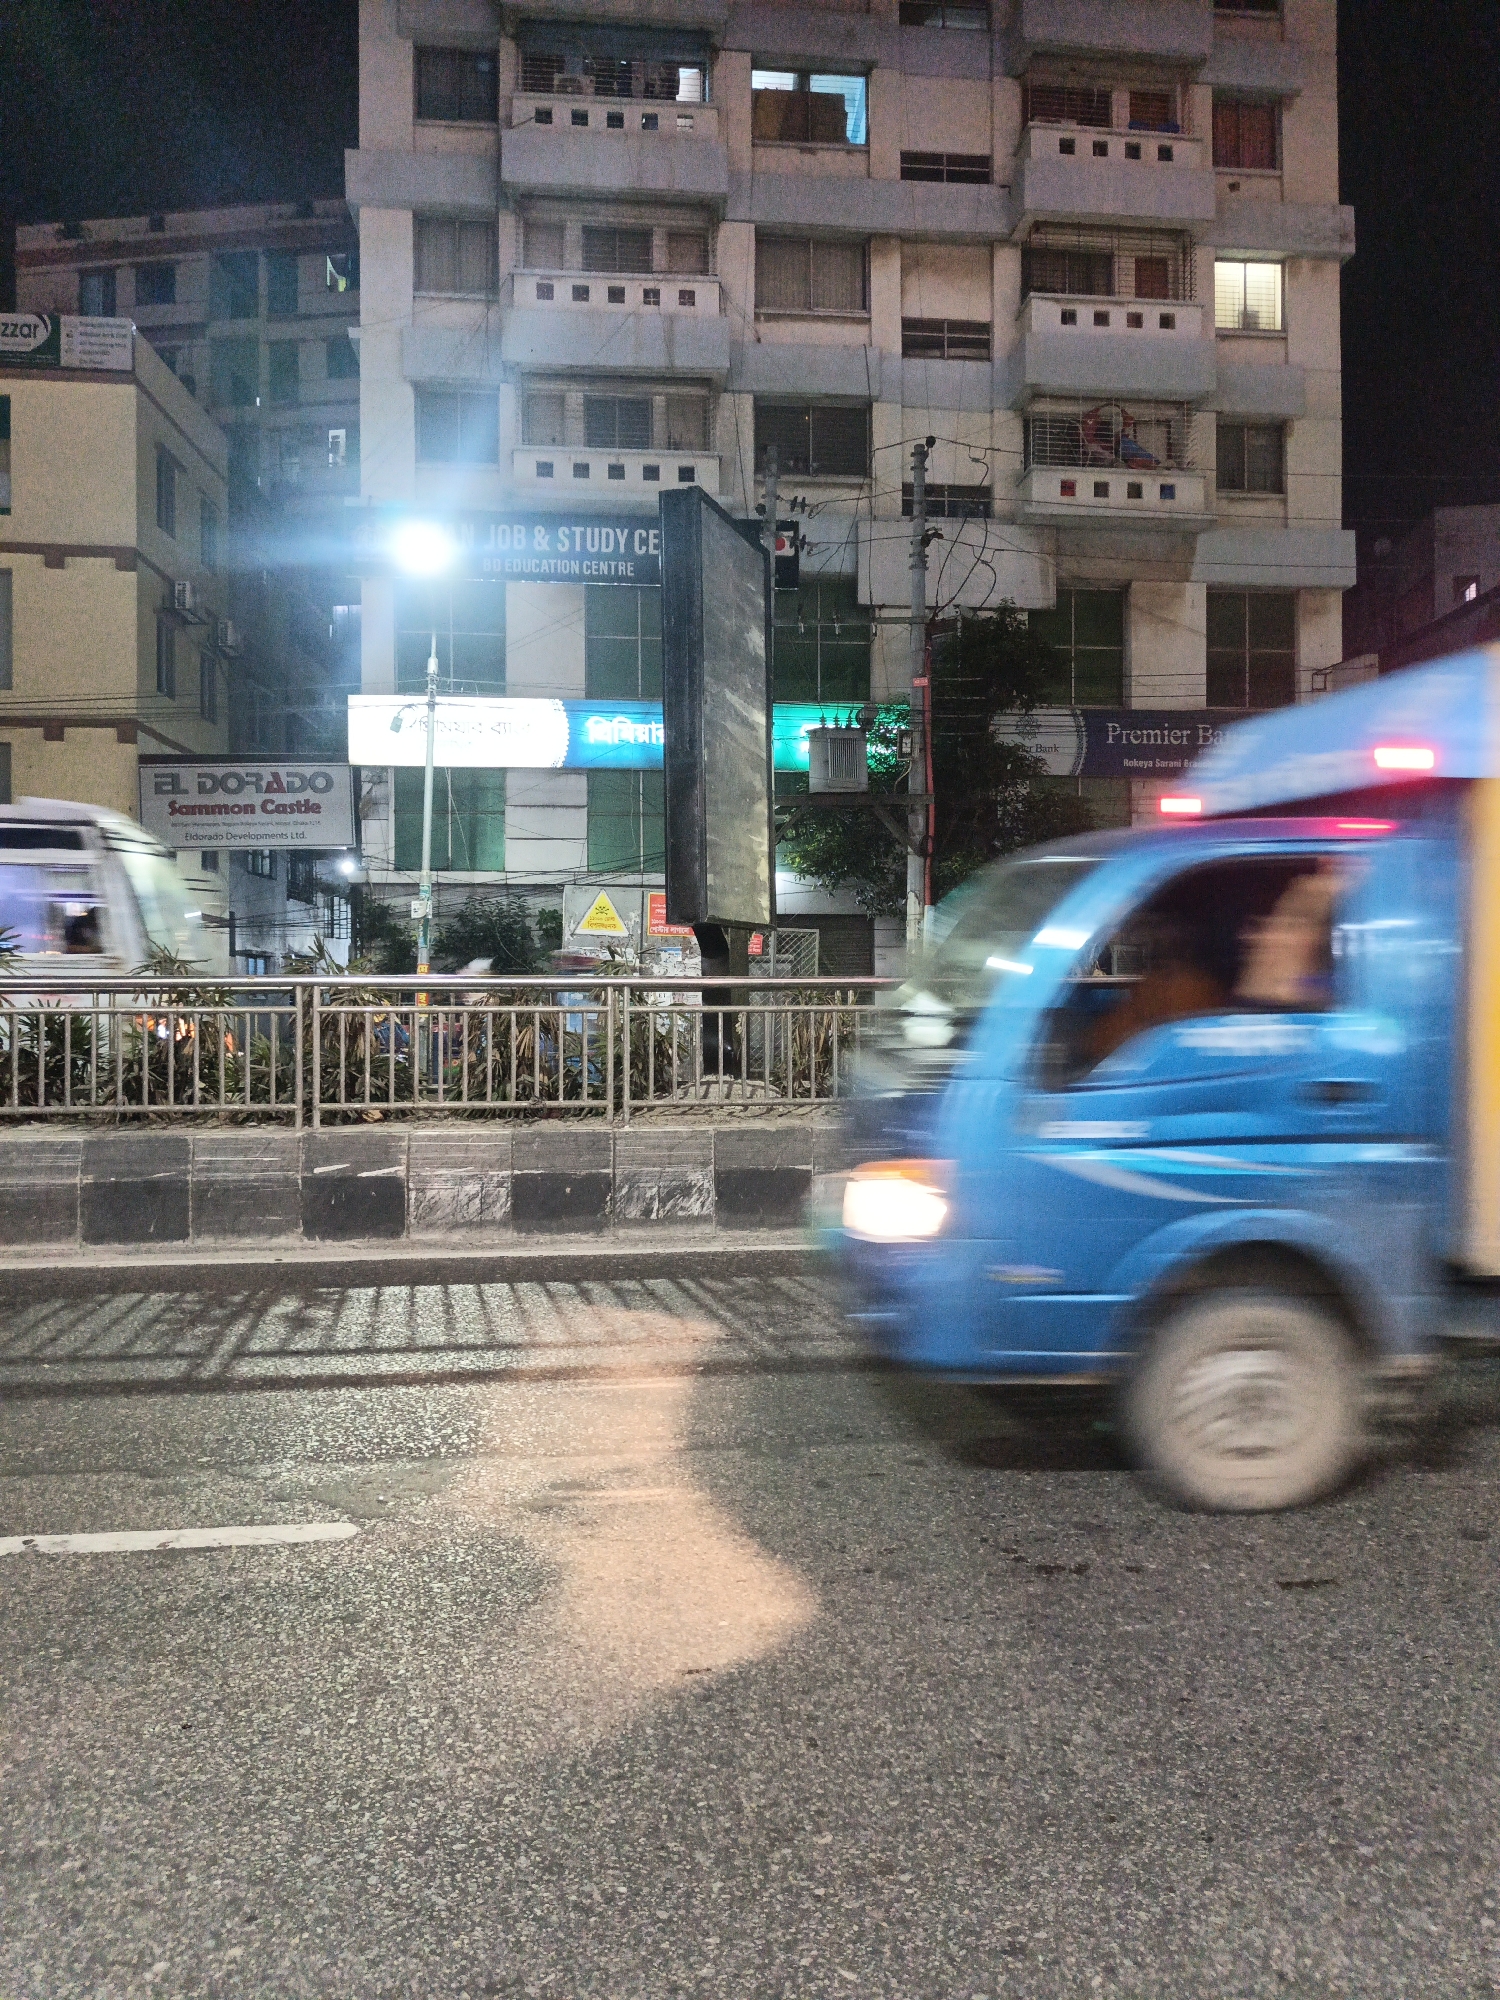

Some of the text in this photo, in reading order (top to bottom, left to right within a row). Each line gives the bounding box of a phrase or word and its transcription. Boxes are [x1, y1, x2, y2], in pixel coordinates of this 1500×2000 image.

[1, 322, 39, 339] zzar
[483, 524, 527, 551] JOB
[532, 525, 551, 551] &
[557, 526, 629, 553] STUDY
[633, 528, 660, 555] CE
[504, 558, 580, 574] EDUCATION
[582, 560, 635, 577] CENTRE
[1105, 722, 1190, 745] Premier
[1123, 758, 1153, 769] Rokeya
[1155, 758, 1181, 768] Sarani
[154, 771, 335, 795] EL DORADO
[168, 798, 322, 817] Sammon Castle
[184, 831, 308, 842] Eldorado Developments Ltd.
